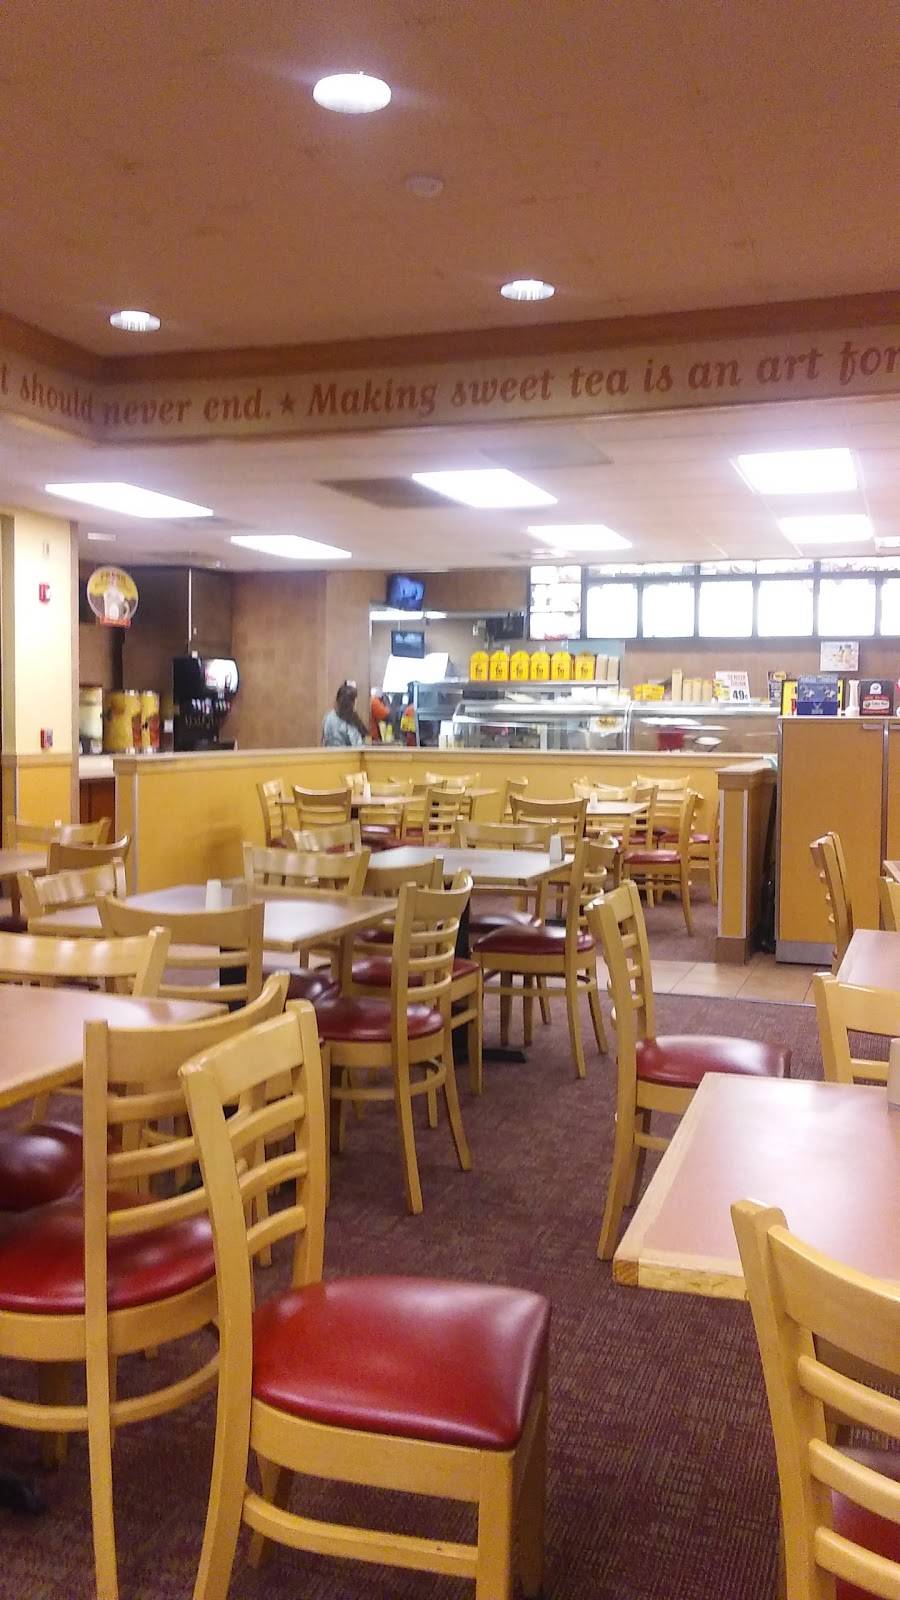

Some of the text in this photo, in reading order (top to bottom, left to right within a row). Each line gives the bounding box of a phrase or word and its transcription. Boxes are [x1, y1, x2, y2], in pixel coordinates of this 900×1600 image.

[20, 372, 92, 422] should
[103, 397, 190, 427] never
[204, 390, 271, 421] end.
[306, 378, 438, 417] Making
[451, 368, 554, 408] sweet
[569, 366, 629, 399] tea
[644, 357, 673, 392] is
[689, 359, 741, 389] an
[757, 348, 823, 382] art
